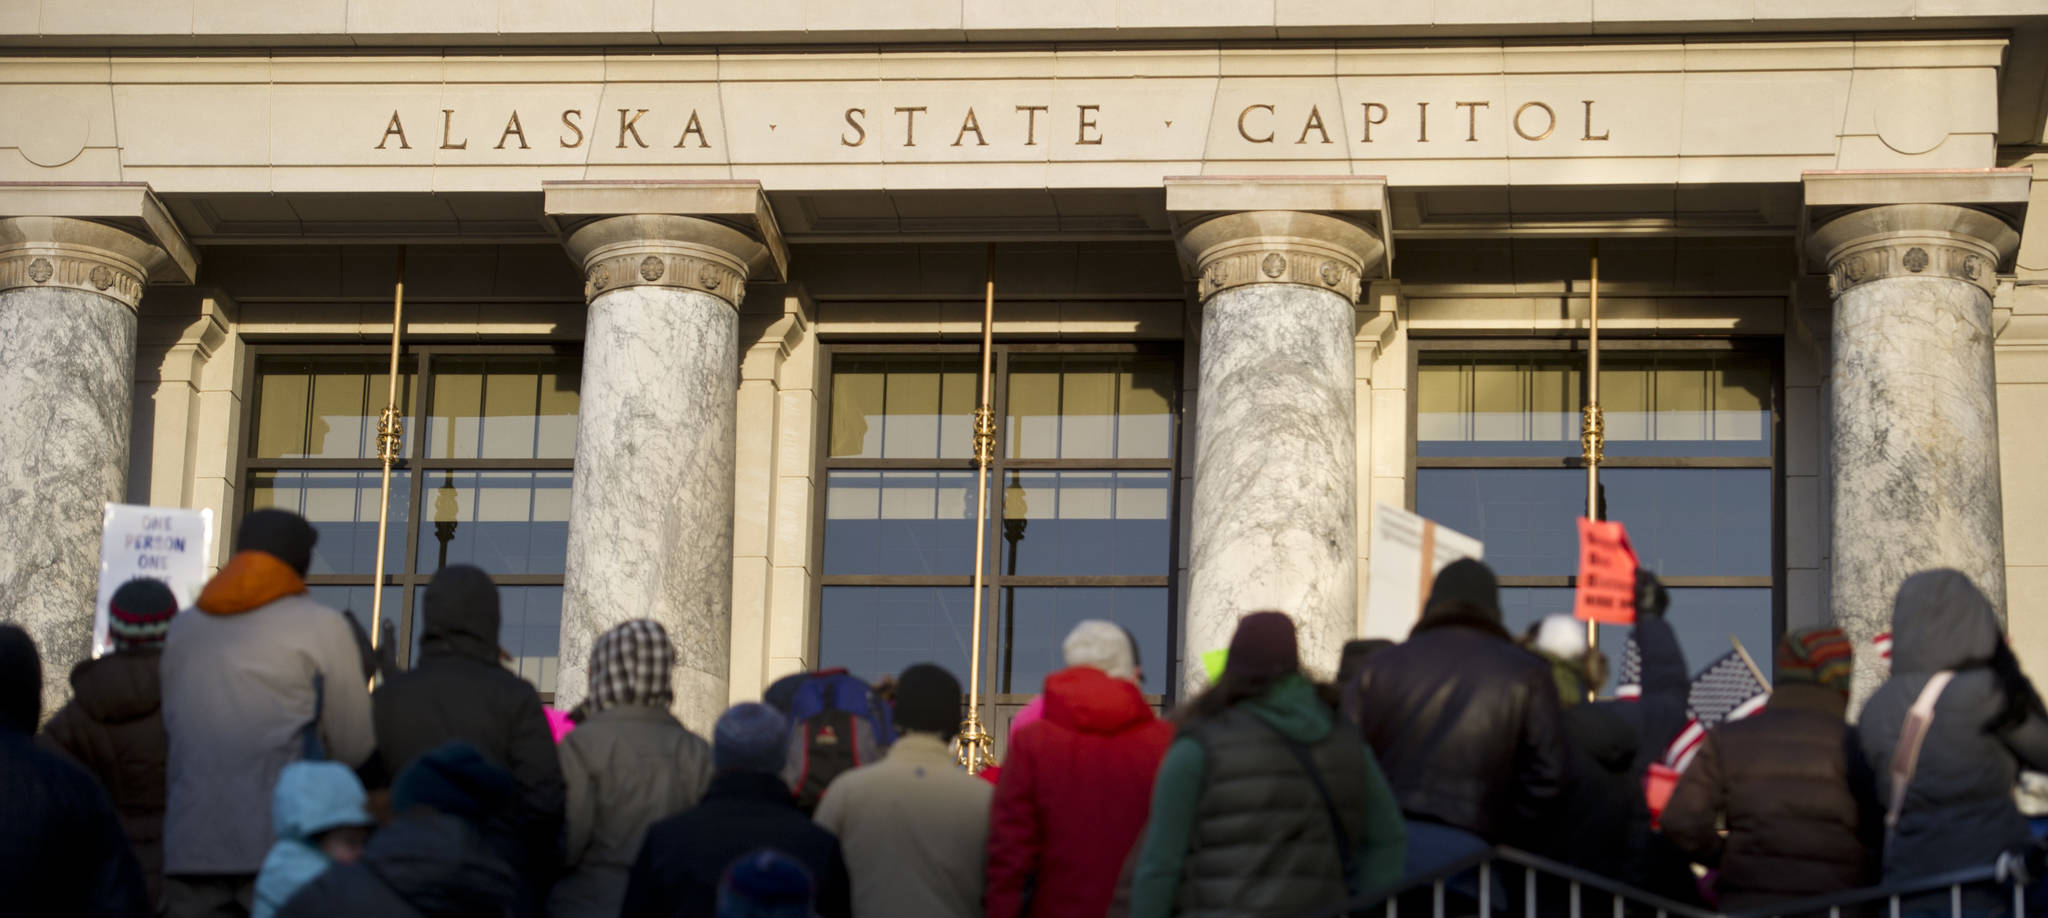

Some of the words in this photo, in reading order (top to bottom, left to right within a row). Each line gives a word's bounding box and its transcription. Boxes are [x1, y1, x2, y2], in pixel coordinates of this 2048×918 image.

[374, 108, 712, 150] ALASKA
[840, 104, 1103, 147] STATE
[1238, 100, 1610, 144] CAPITOL
[143, 515, 172, 531] ONE
[125, 534, 186, 552] PERSON
[138, 554, 168, 569] ONE
